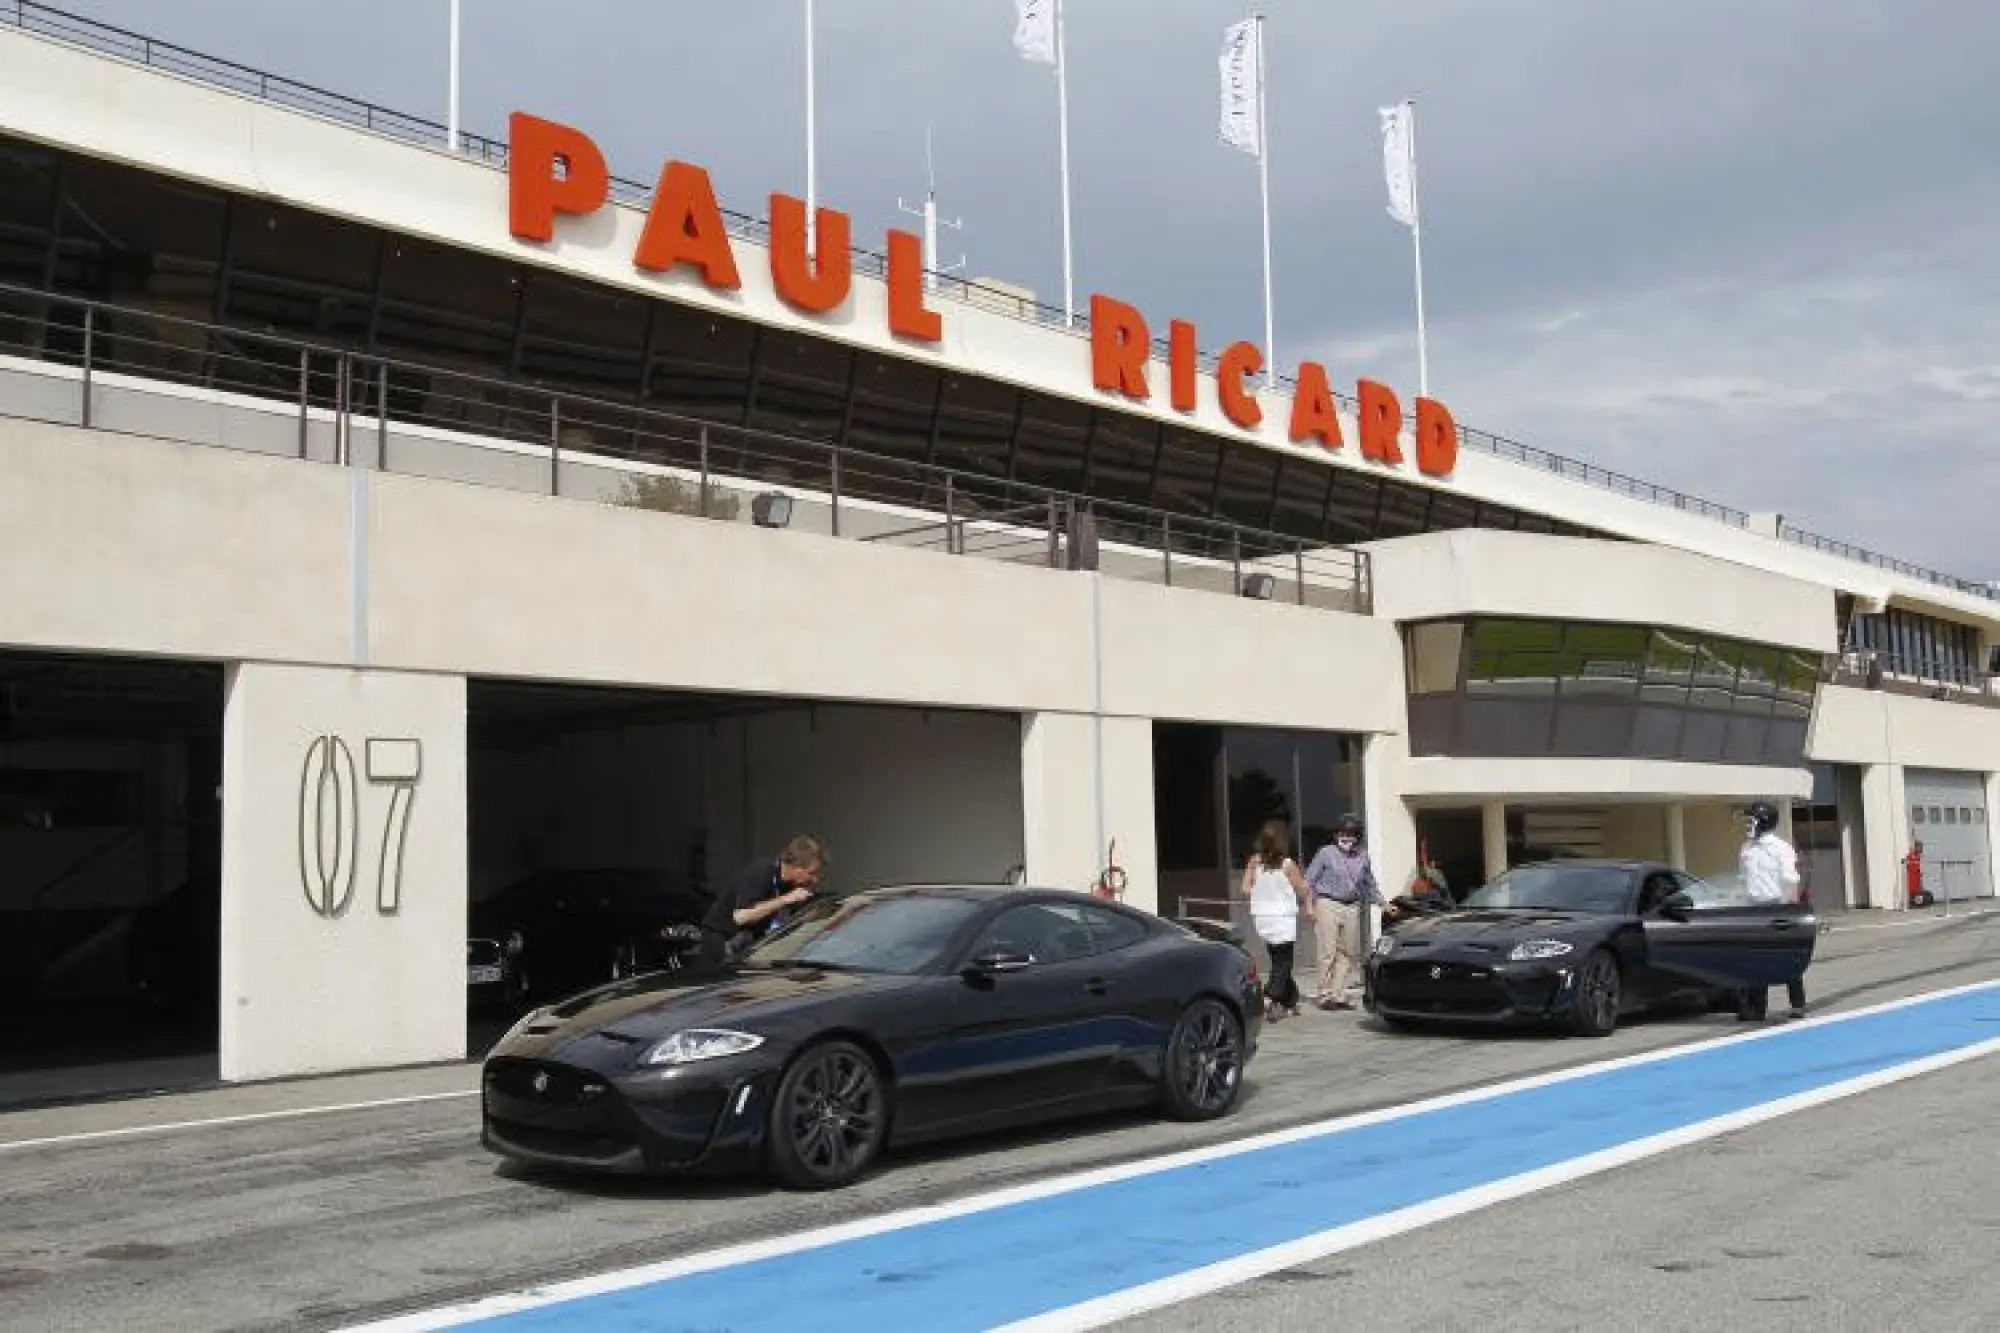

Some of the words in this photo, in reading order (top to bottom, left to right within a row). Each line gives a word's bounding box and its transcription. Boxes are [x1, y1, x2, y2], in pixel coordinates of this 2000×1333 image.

[509, 112, 943, 342] PAUL
[1089, 294, 1458, 476] RICARD
[300, 734, 422, 917] 07
